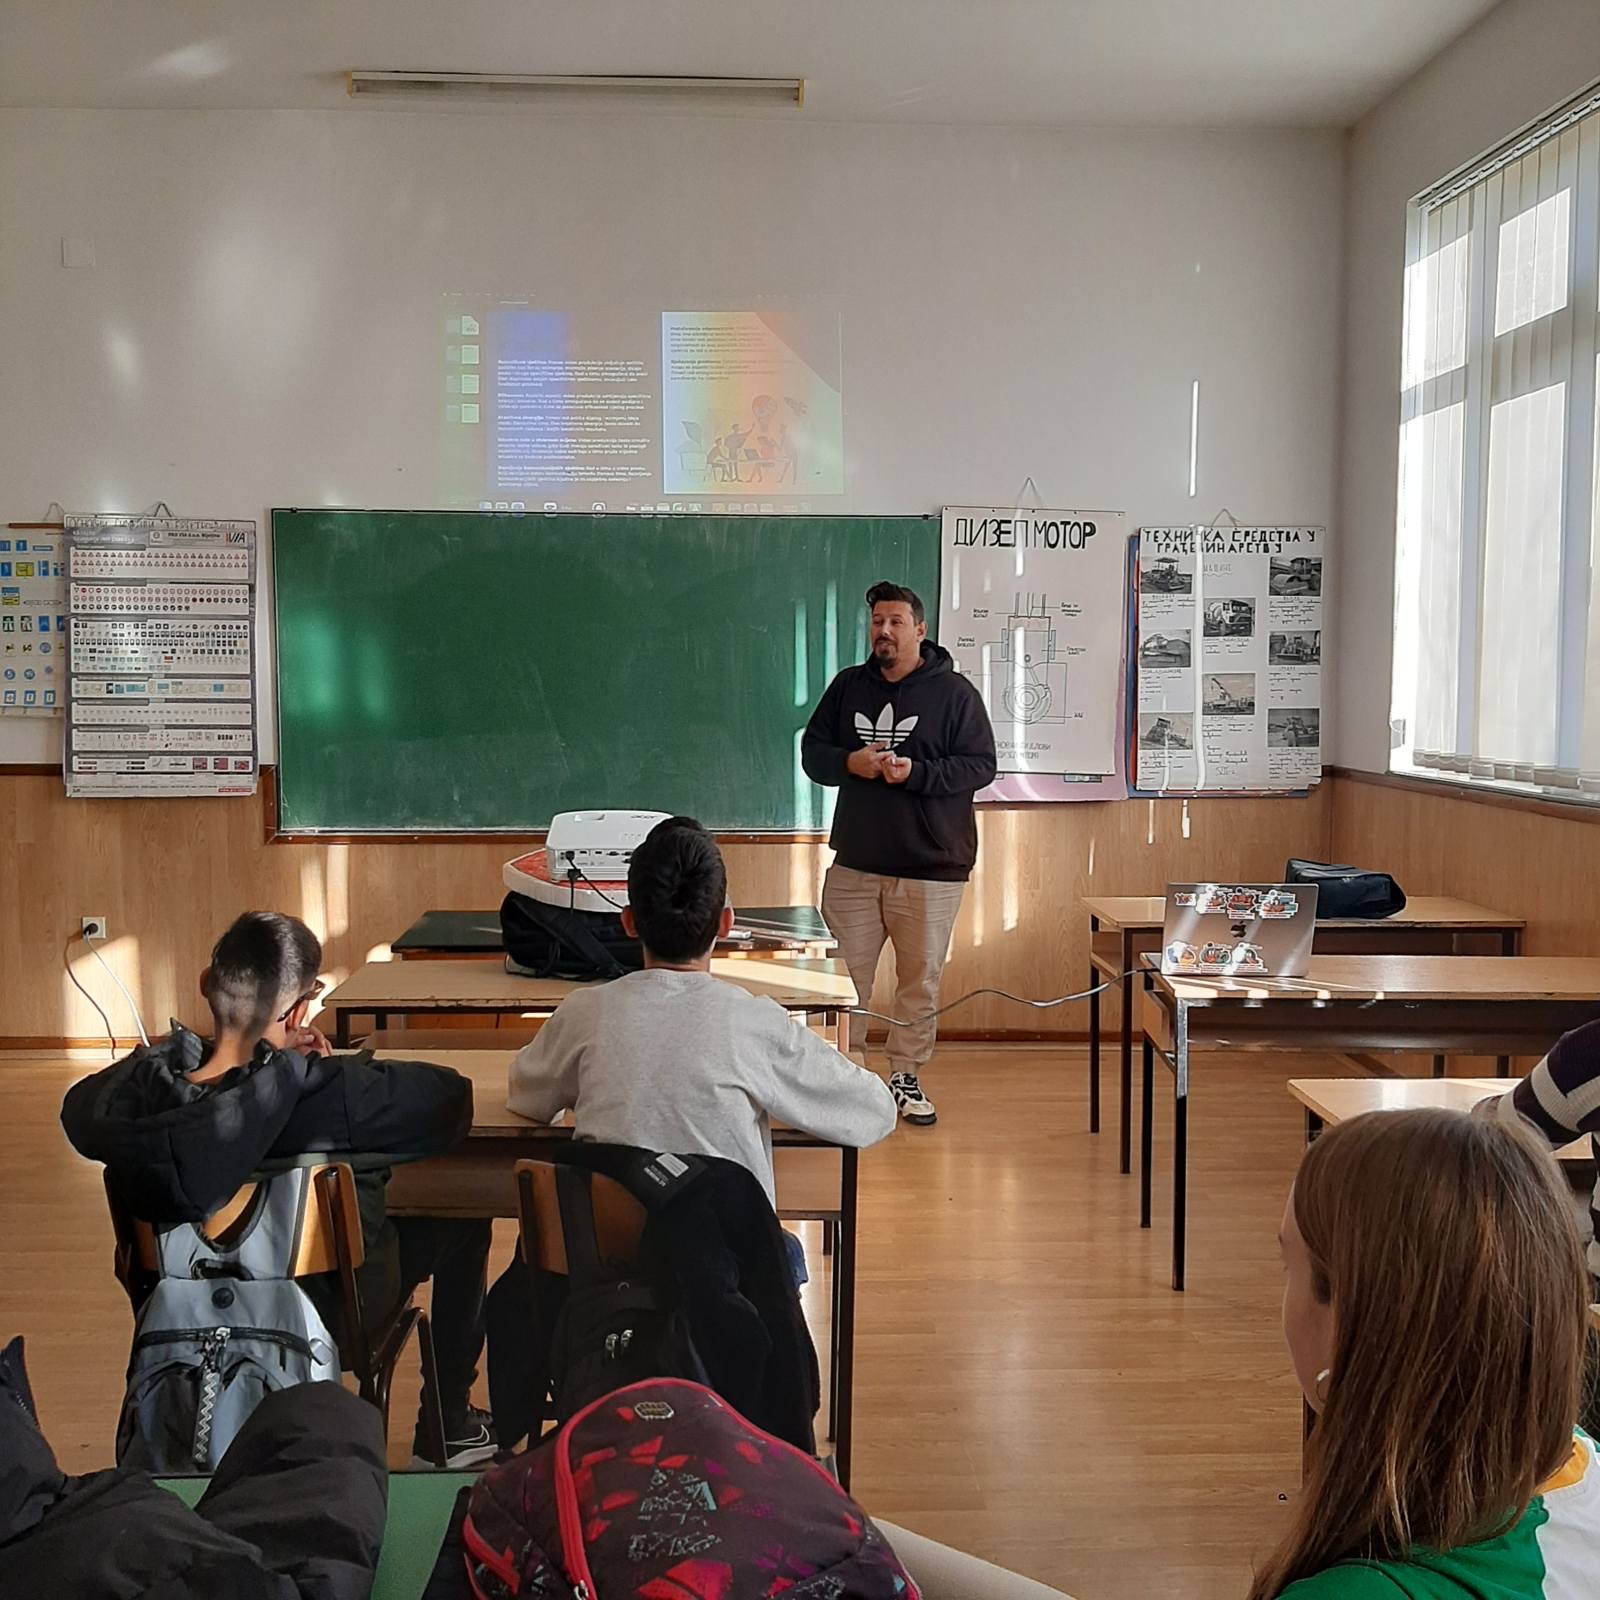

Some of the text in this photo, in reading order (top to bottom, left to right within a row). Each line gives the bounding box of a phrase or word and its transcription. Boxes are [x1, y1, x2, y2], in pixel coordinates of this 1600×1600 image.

[1034, 520, 1097, 549] МОТОР
[1144, 530, 1224, 542] ТЕХНИКА
[1232, 530, 1300, 543] СРЕДСТВА
[1157, 542, 1282, 555] ГРАЂЕИНАРСТВУ
